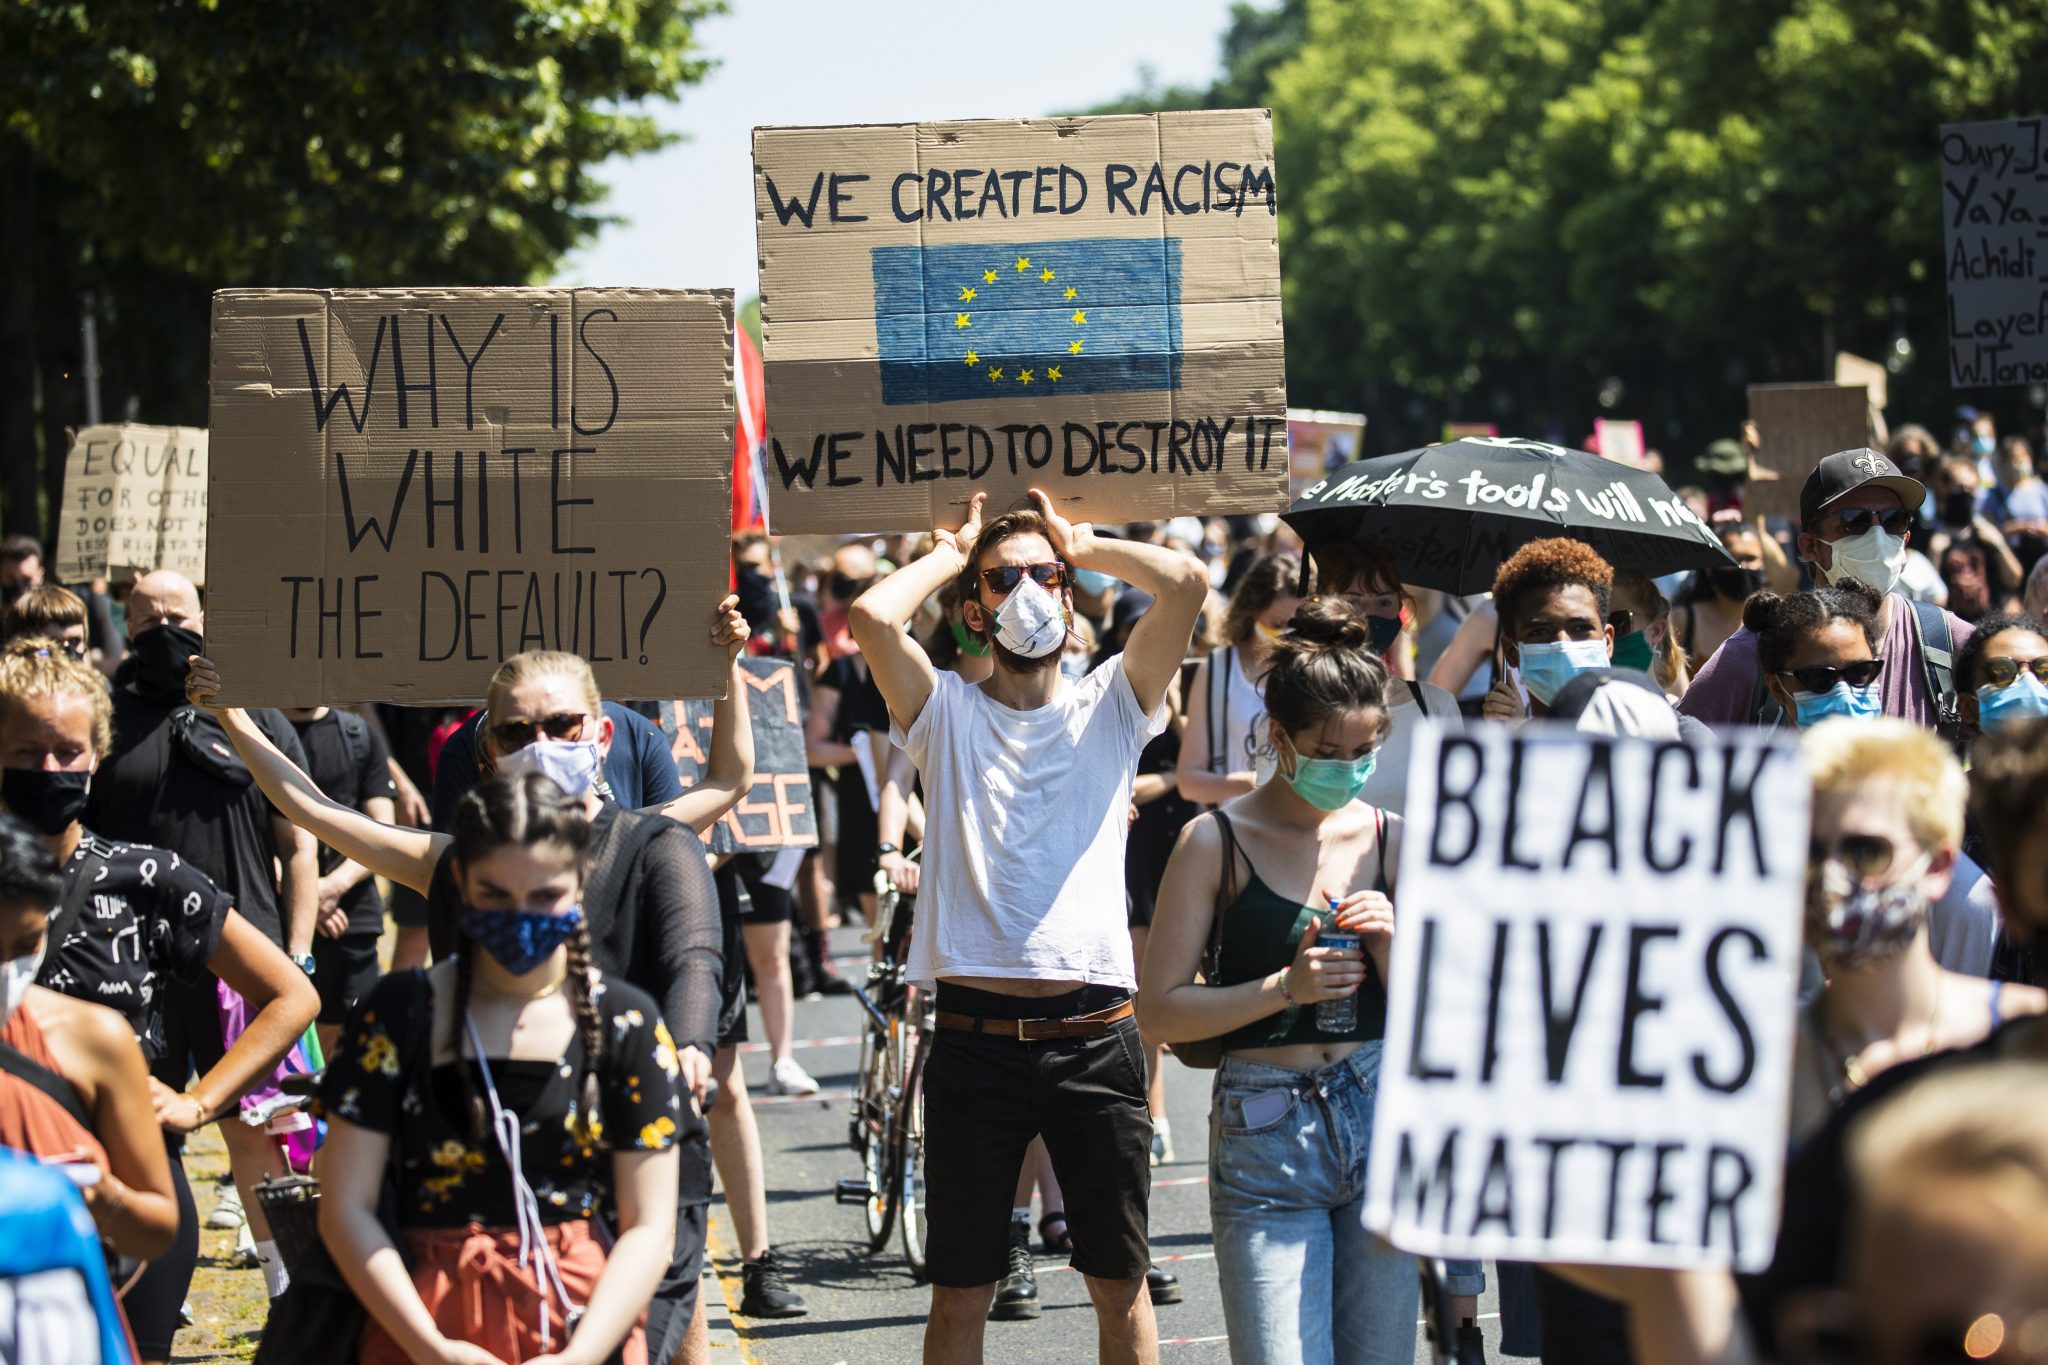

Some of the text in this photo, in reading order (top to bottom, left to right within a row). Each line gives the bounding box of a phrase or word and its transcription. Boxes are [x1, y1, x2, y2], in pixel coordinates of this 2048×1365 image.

[762, 157, 1276, 229] WE CREATED RACISM
[1941, 133, 2015, 180] Oury
[1950, 236, 2035, 281] Achidi
[297, 309, 619, 436] WHY IS
[84, 440, 200, 477] EQUAL
[771, 416, 1287, 491] WE NEED TO DESTROY IT
[76, 516, 138, 537] DOES
[77, 486, 131, 511] FOR
[335, 448, 597, 554] WHITE
[1319, 467, 1450, 503] Master's
[1458, 469, 1571, 510] tools
[1575, 481, 1647, 523] will
[281, 567, 667, 666] THE DEFAULT?
[1430, 736, 1771, 878] BLACK
[1408, 919, 1769, 1095] LIVES
[1389, 1128, 1755, 1260] MATTER
